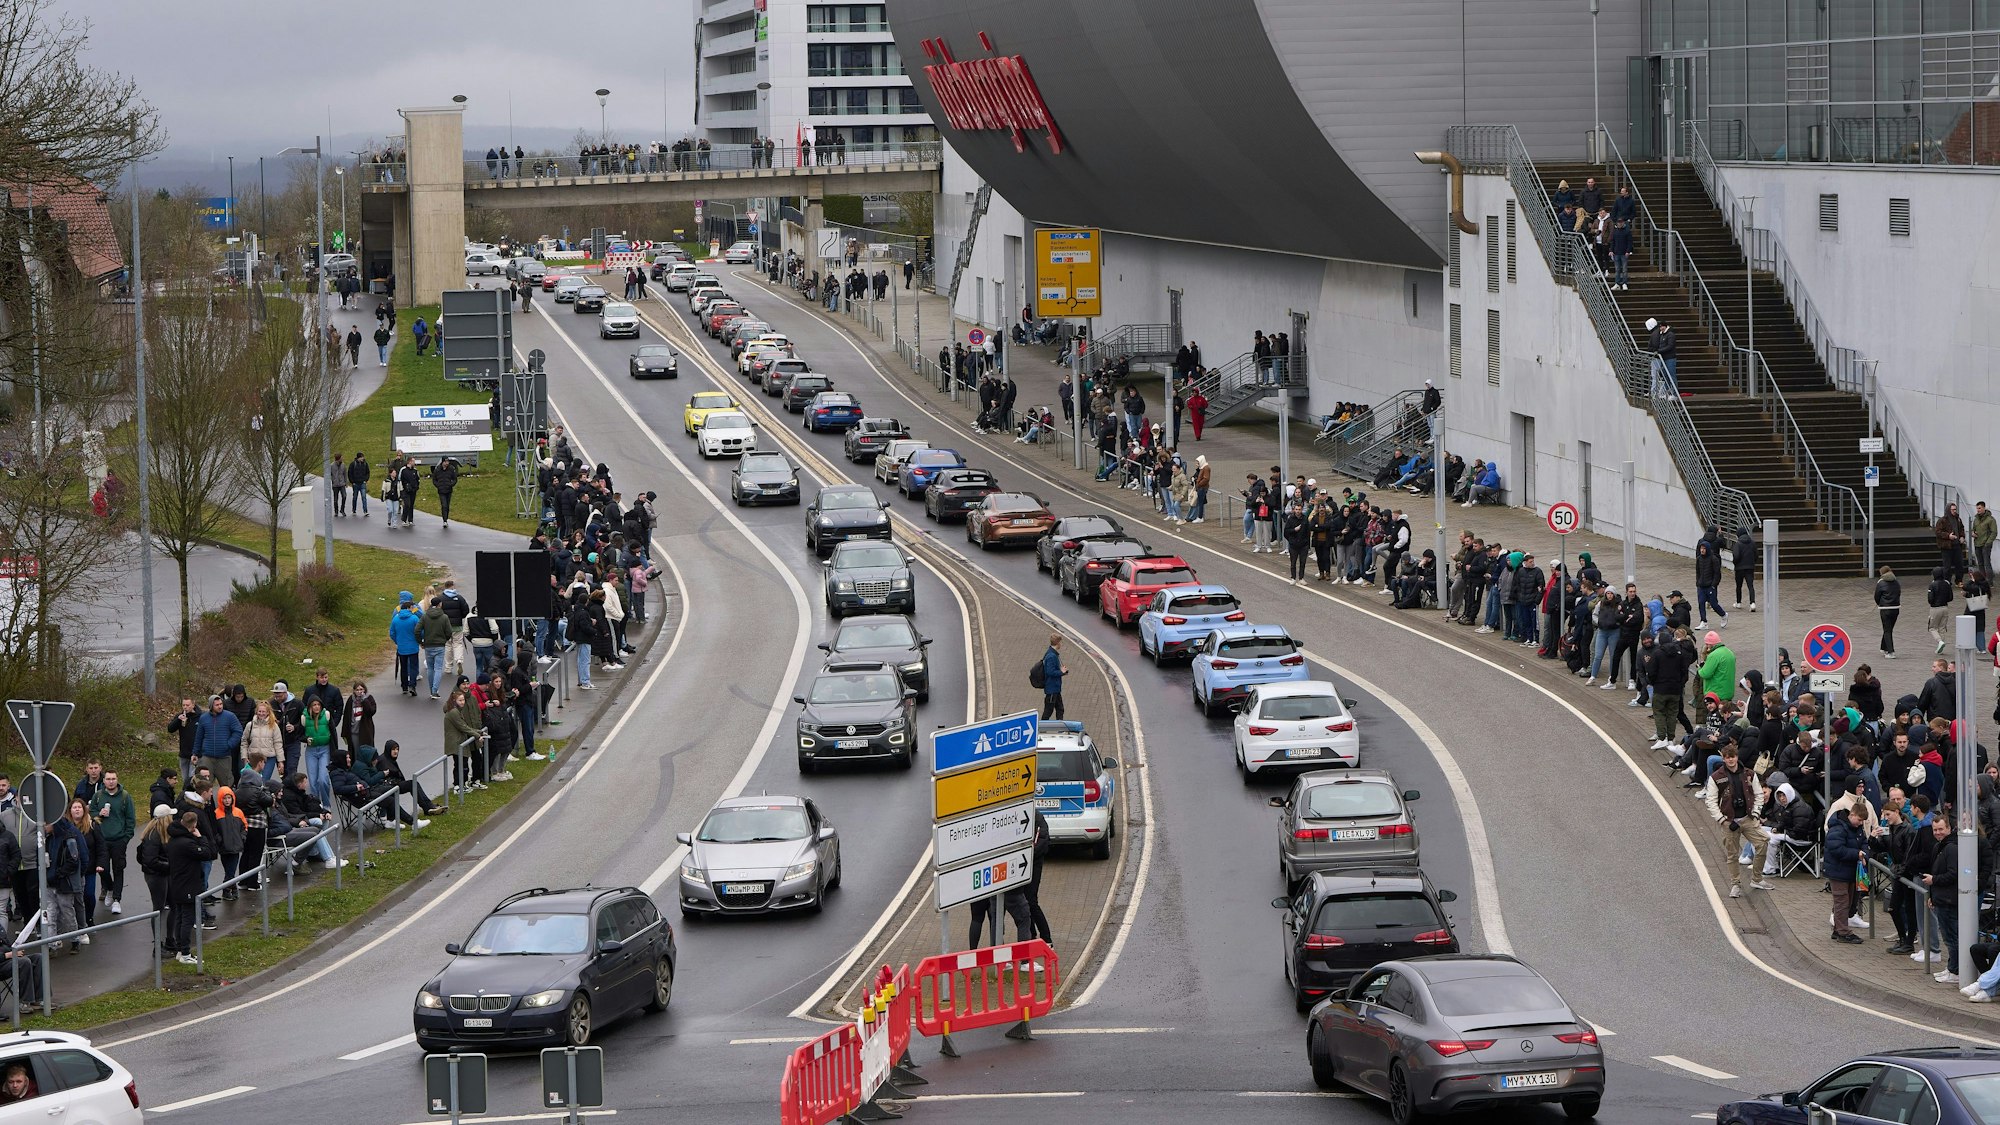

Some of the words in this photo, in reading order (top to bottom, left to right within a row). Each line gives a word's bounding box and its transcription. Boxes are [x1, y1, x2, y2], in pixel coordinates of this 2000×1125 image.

[1555, 511, 1572, 525] 50
[1011, 730, 1019, 741] 48
[996, 768, 1020, 782] Aachen
[977, 780, 1019, 801] Blankenheim
[949, 822, 988, 842] Fahrerlager
[992, 811, 1019, 829] Paddock
[1507, 1076, 1519, 1086] MY
[1525, 1074, 1537, 1085] XX
[1539, 1073, 1556, 1084] 130
